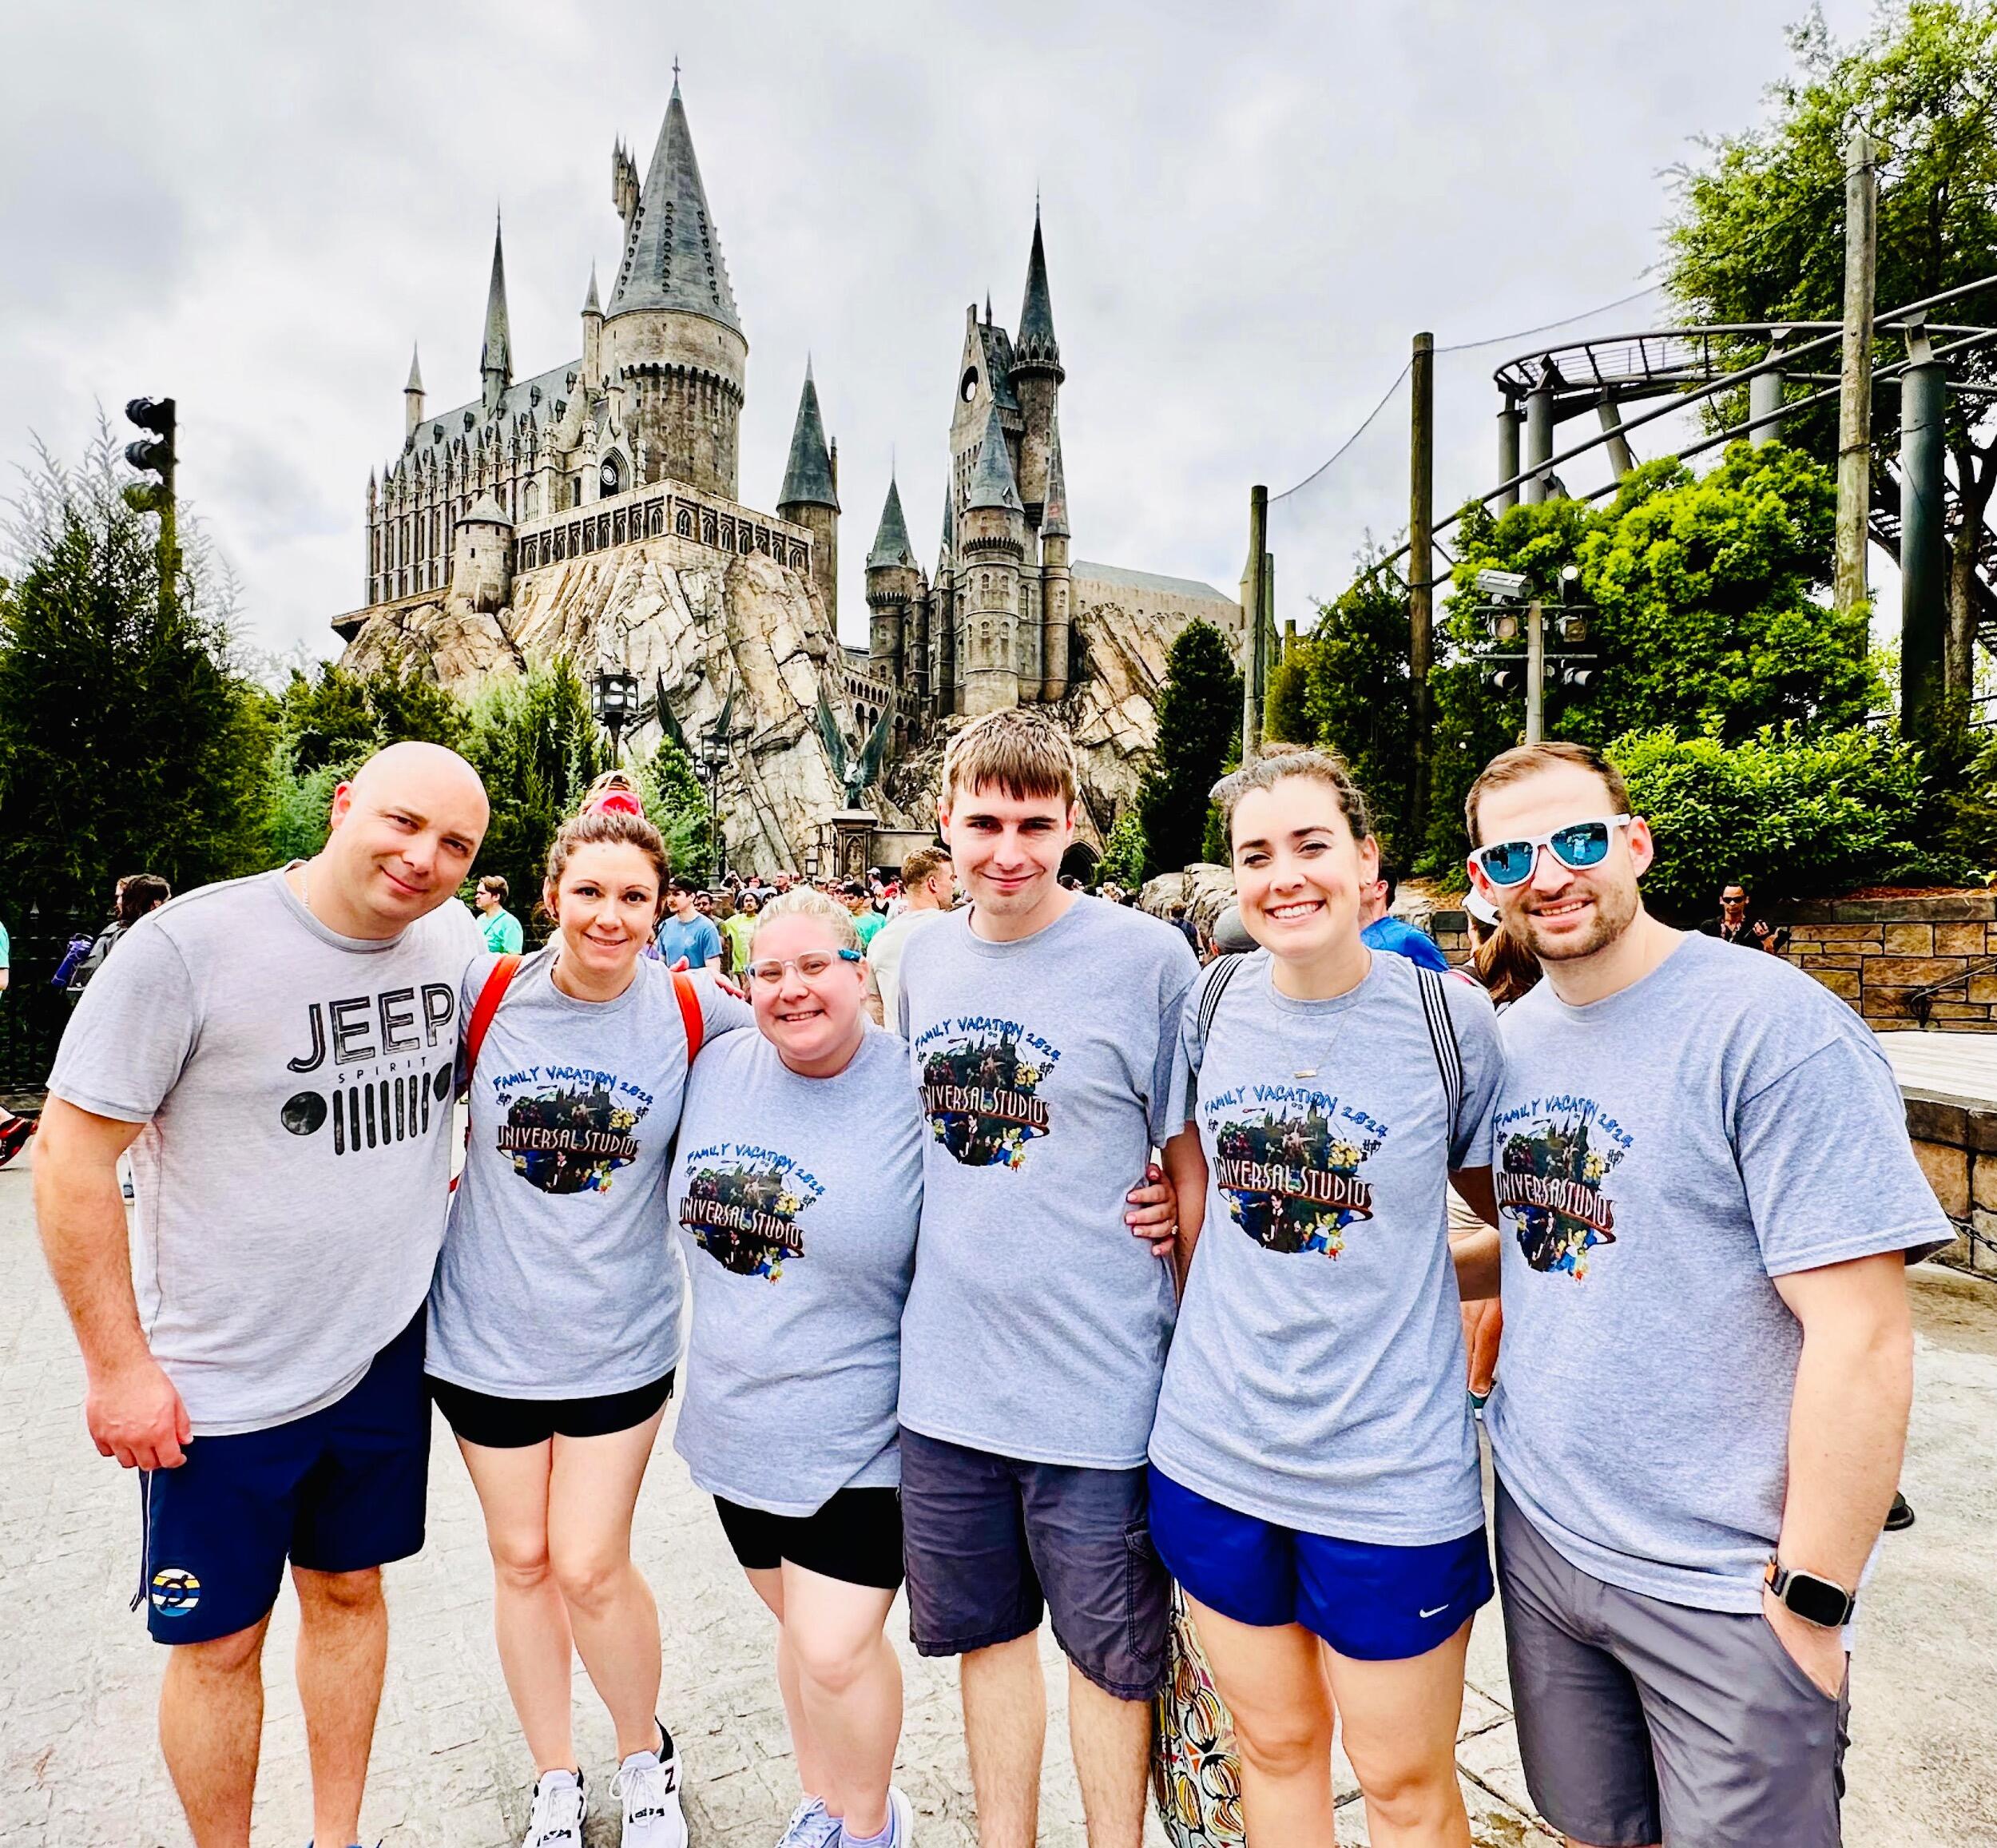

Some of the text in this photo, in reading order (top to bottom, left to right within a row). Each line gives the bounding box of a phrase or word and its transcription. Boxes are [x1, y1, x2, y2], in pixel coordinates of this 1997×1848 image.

[287, 983, 455, 1073] JEEP
[957, 1016, 1024, 1042] VACATION
[1026, 1032, 1062, 1062] 2024
[338, 1056, 427, 1083] SPIRIT
[493, 1065, 653, 1106] FAMILY VACATION 2024
[1205, 1084, 1389, 1139] FAMILY VACATION 2024
[687, 1143, 731, 1163] FAMILY
